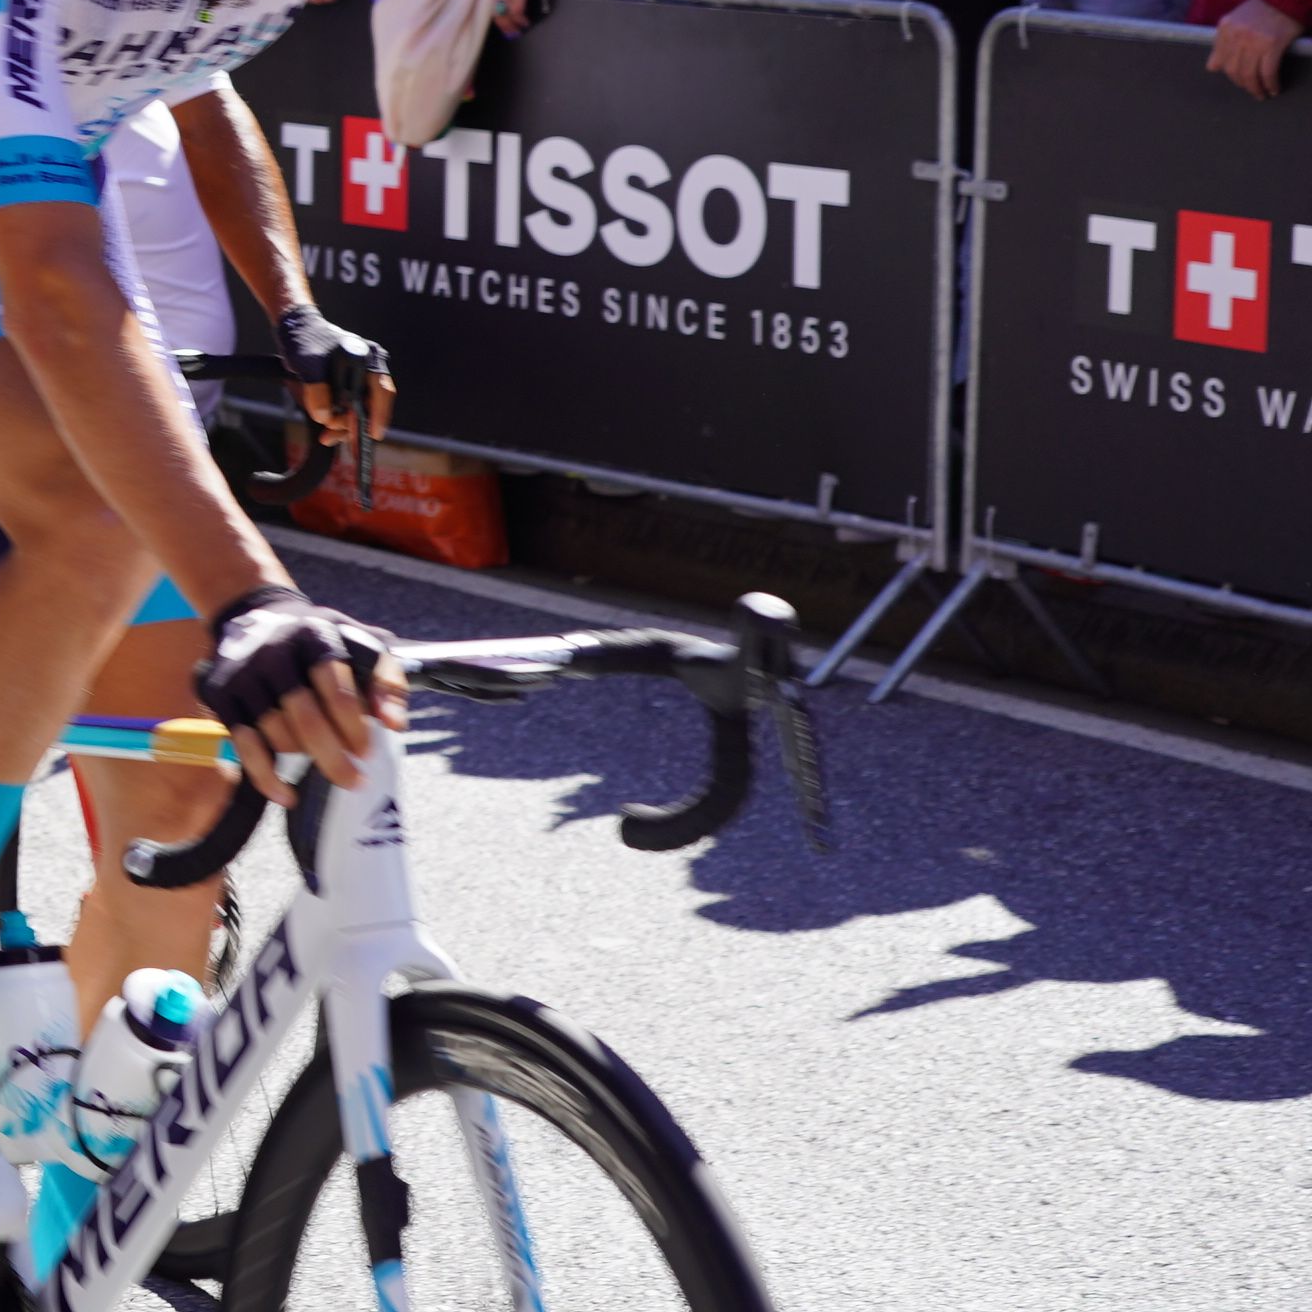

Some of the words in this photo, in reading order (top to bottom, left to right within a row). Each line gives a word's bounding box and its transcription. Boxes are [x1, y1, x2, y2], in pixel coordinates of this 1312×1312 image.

[423, 128, 850, 289] TISSOT
[300, 242, 381, 287] WISS
[400, 258, 580, 318] WATCHES
[602, 287, 727, 341] SINCE
[749, 309, 851, 359] 1853
[1070, 355, 1227, 419] SWISS
[48, 914, 301, 1312] MERIDA
